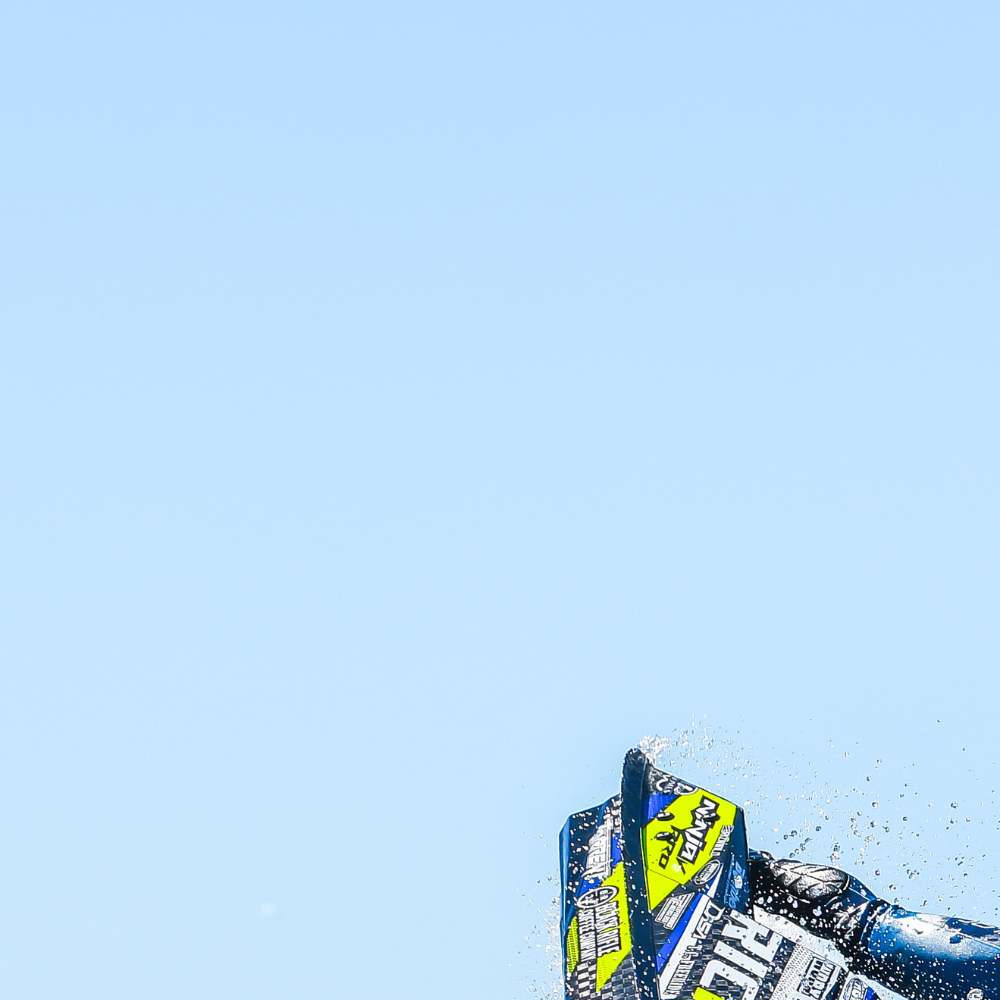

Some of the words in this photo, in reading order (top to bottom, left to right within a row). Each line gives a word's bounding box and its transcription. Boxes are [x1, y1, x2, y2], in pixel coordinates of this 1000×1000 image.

[679, 796, 720, 863] Ninja
[578, 908, 595, 935] COFFEE
[594, 901, 619, 932] BLACK
[580, 932, 597, 961] COMPANY
[596, 928, 621, 957] RIFLE
